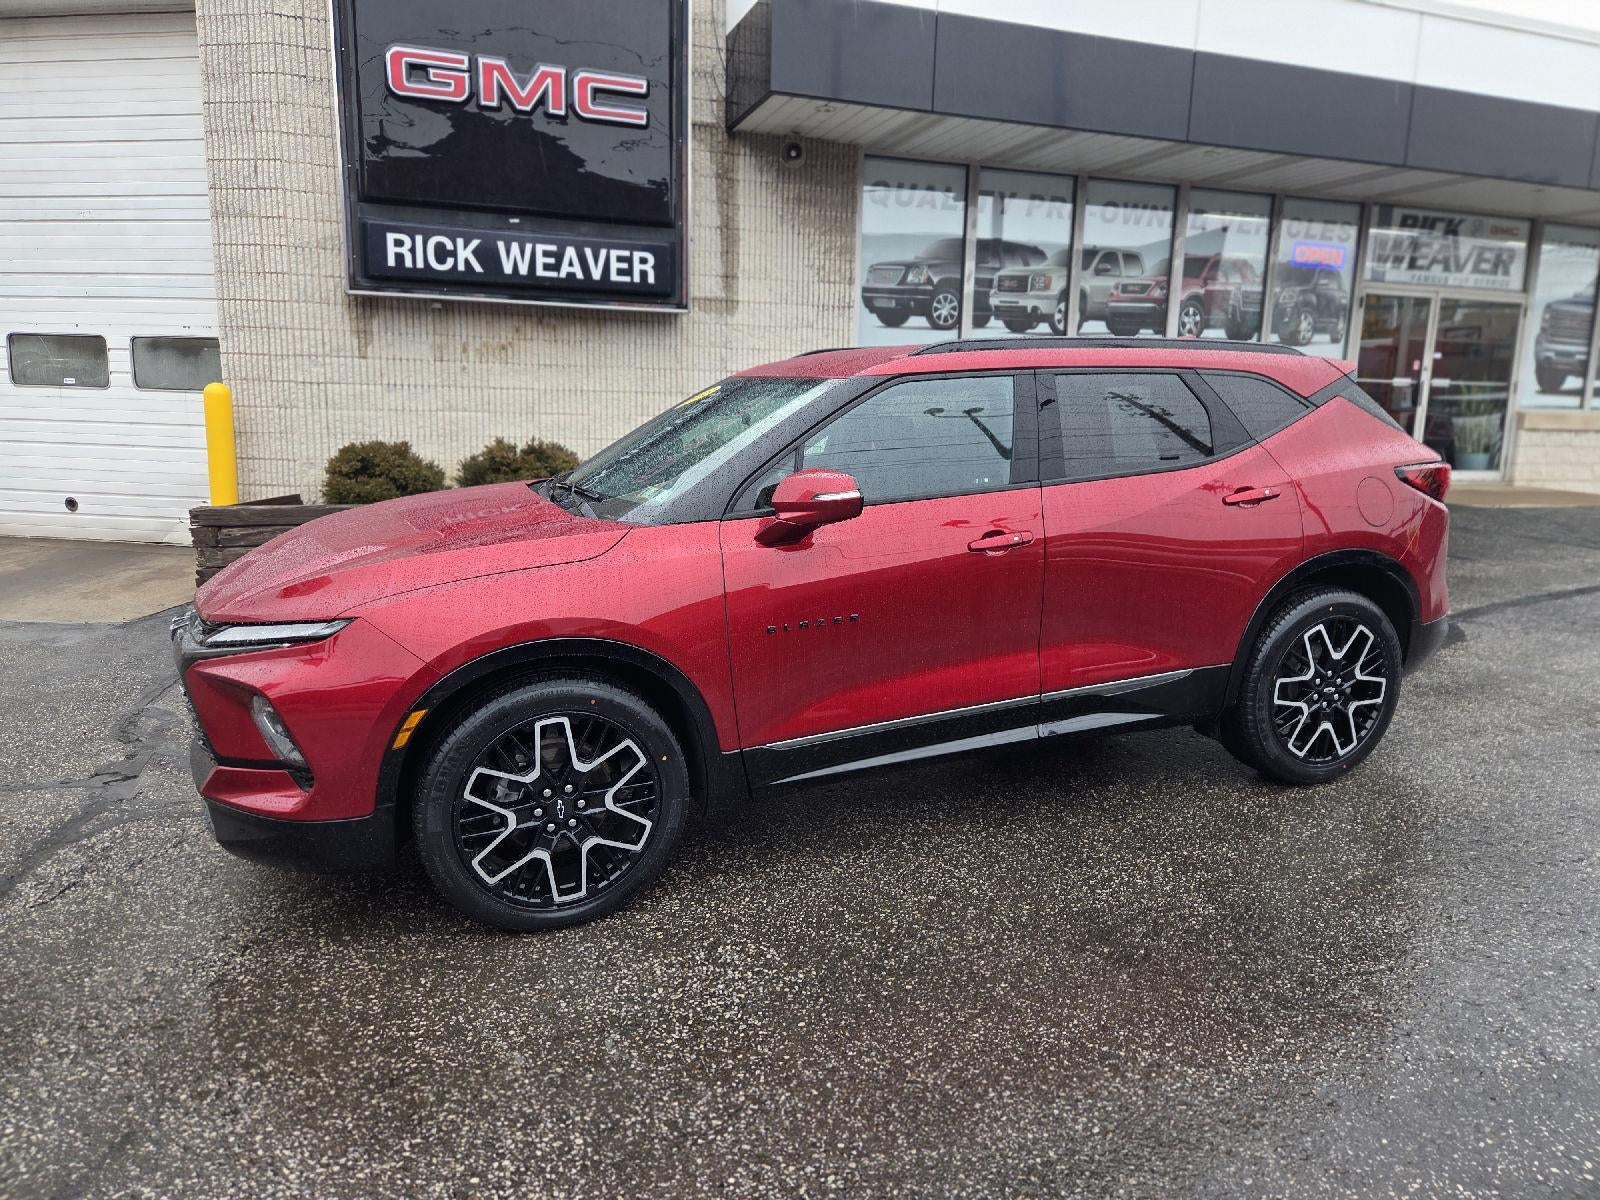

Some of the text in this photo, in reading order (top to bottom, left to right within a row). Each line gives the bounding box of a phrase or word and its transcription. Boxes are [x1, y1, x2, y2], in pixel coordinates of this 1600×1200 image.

[386, 46, 648, 125] GMC
[386, 232, 656, 284] RICK WEAVER
[1296, 246, 1345, 265] OPEN
[1375, 234, 1517, 277] WEAVER
[767, 613, 859, 634] BLAZER
